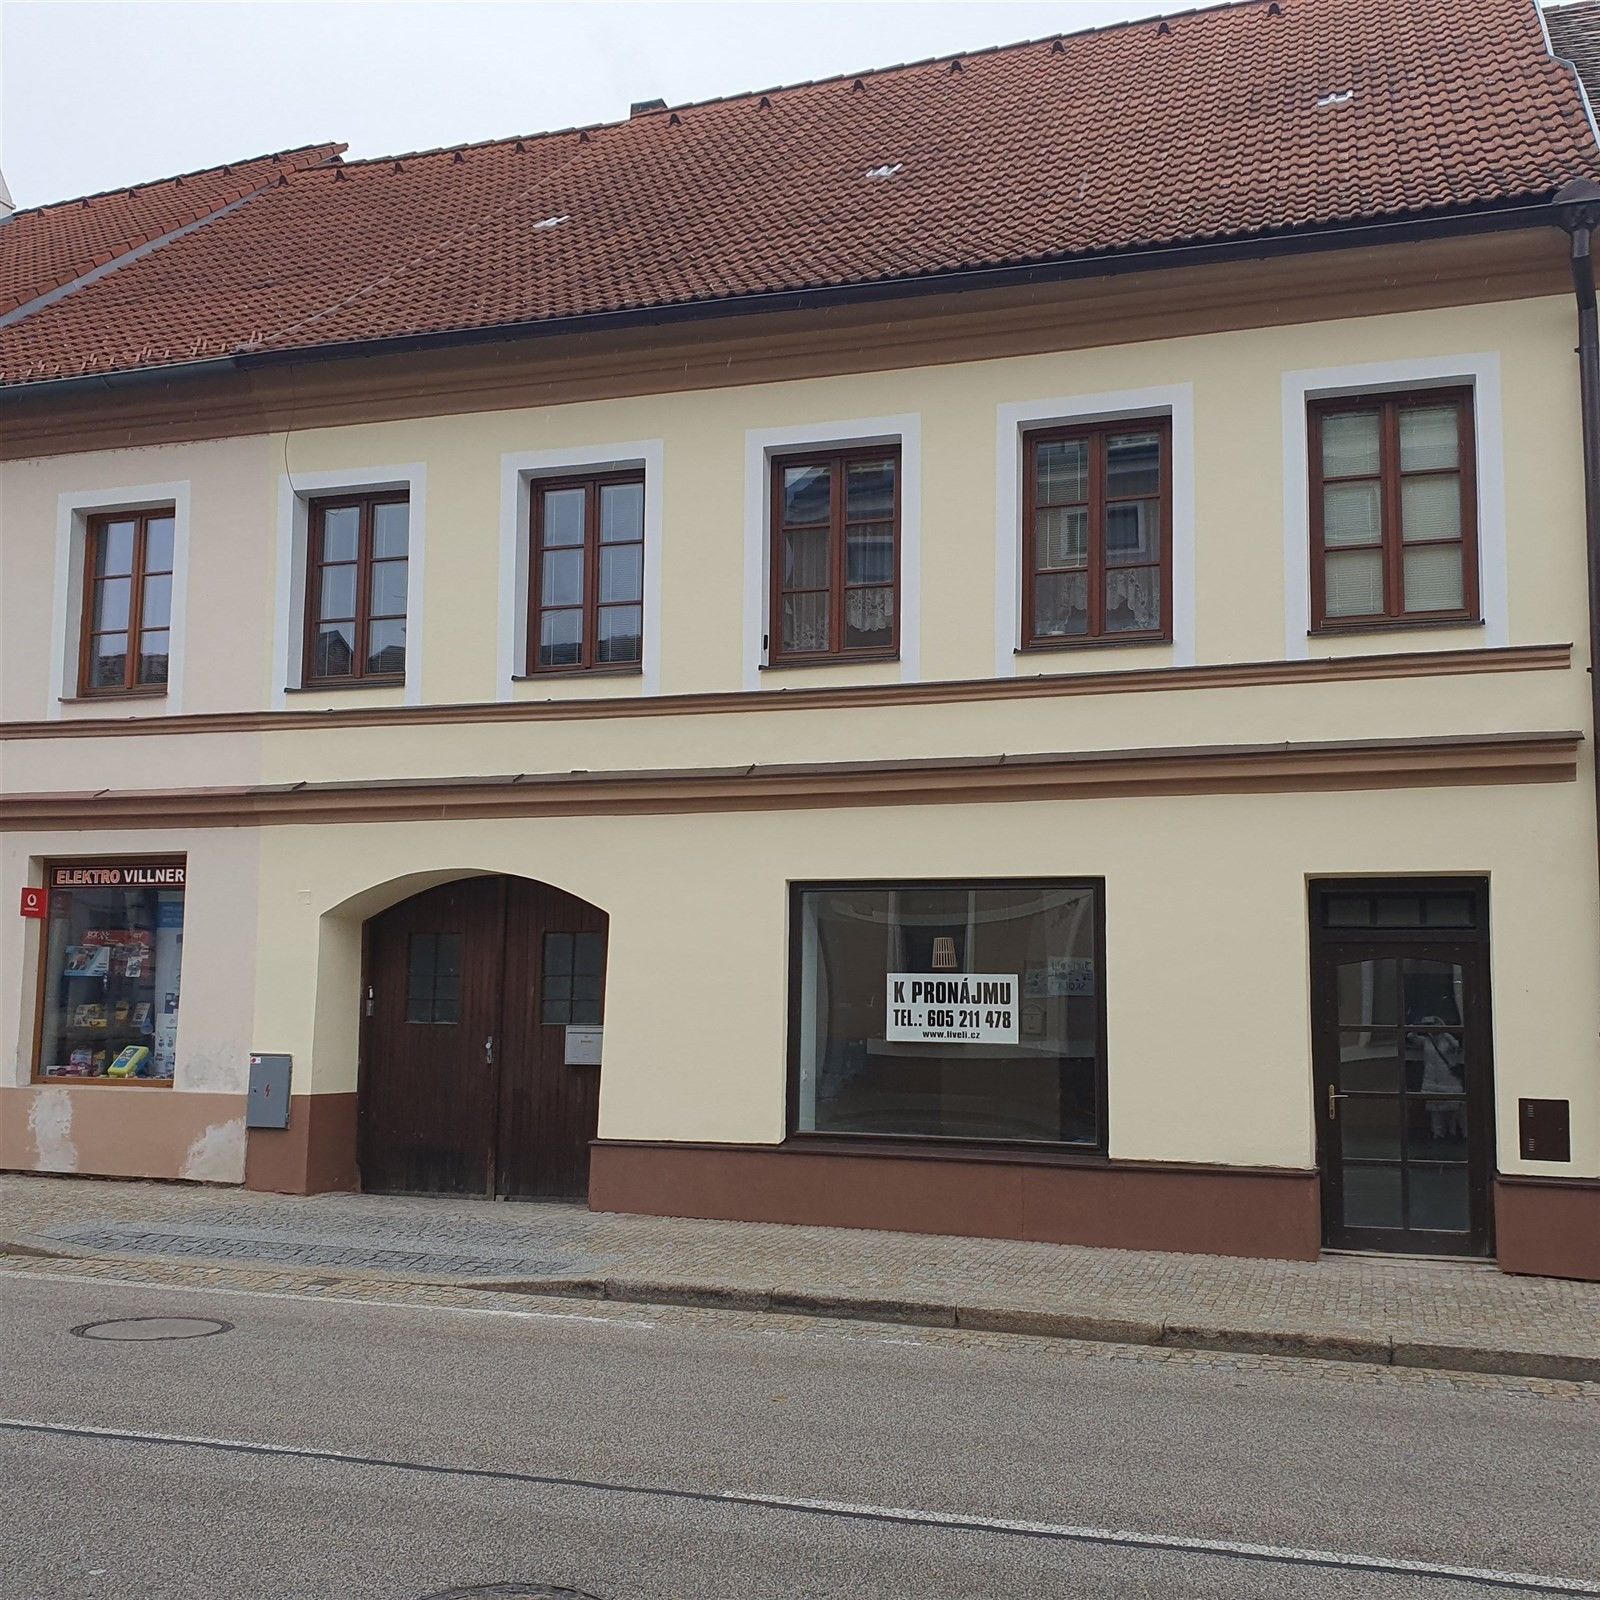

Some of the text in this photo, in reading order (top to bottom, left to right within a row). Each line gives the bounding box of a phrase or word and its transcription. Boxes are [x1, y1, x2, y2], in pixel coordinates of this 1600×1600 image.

[56, 869, 184, 884] ELEKTRO VILLNER
[893, 981, 905, 1004] K
[911, 977, 1011, 1005] PRONÁJMU
[893, 1009, 1011, 1029] TEL.: 605 211 478
[922, 1030, 980, 1039] www.liveli.cz
